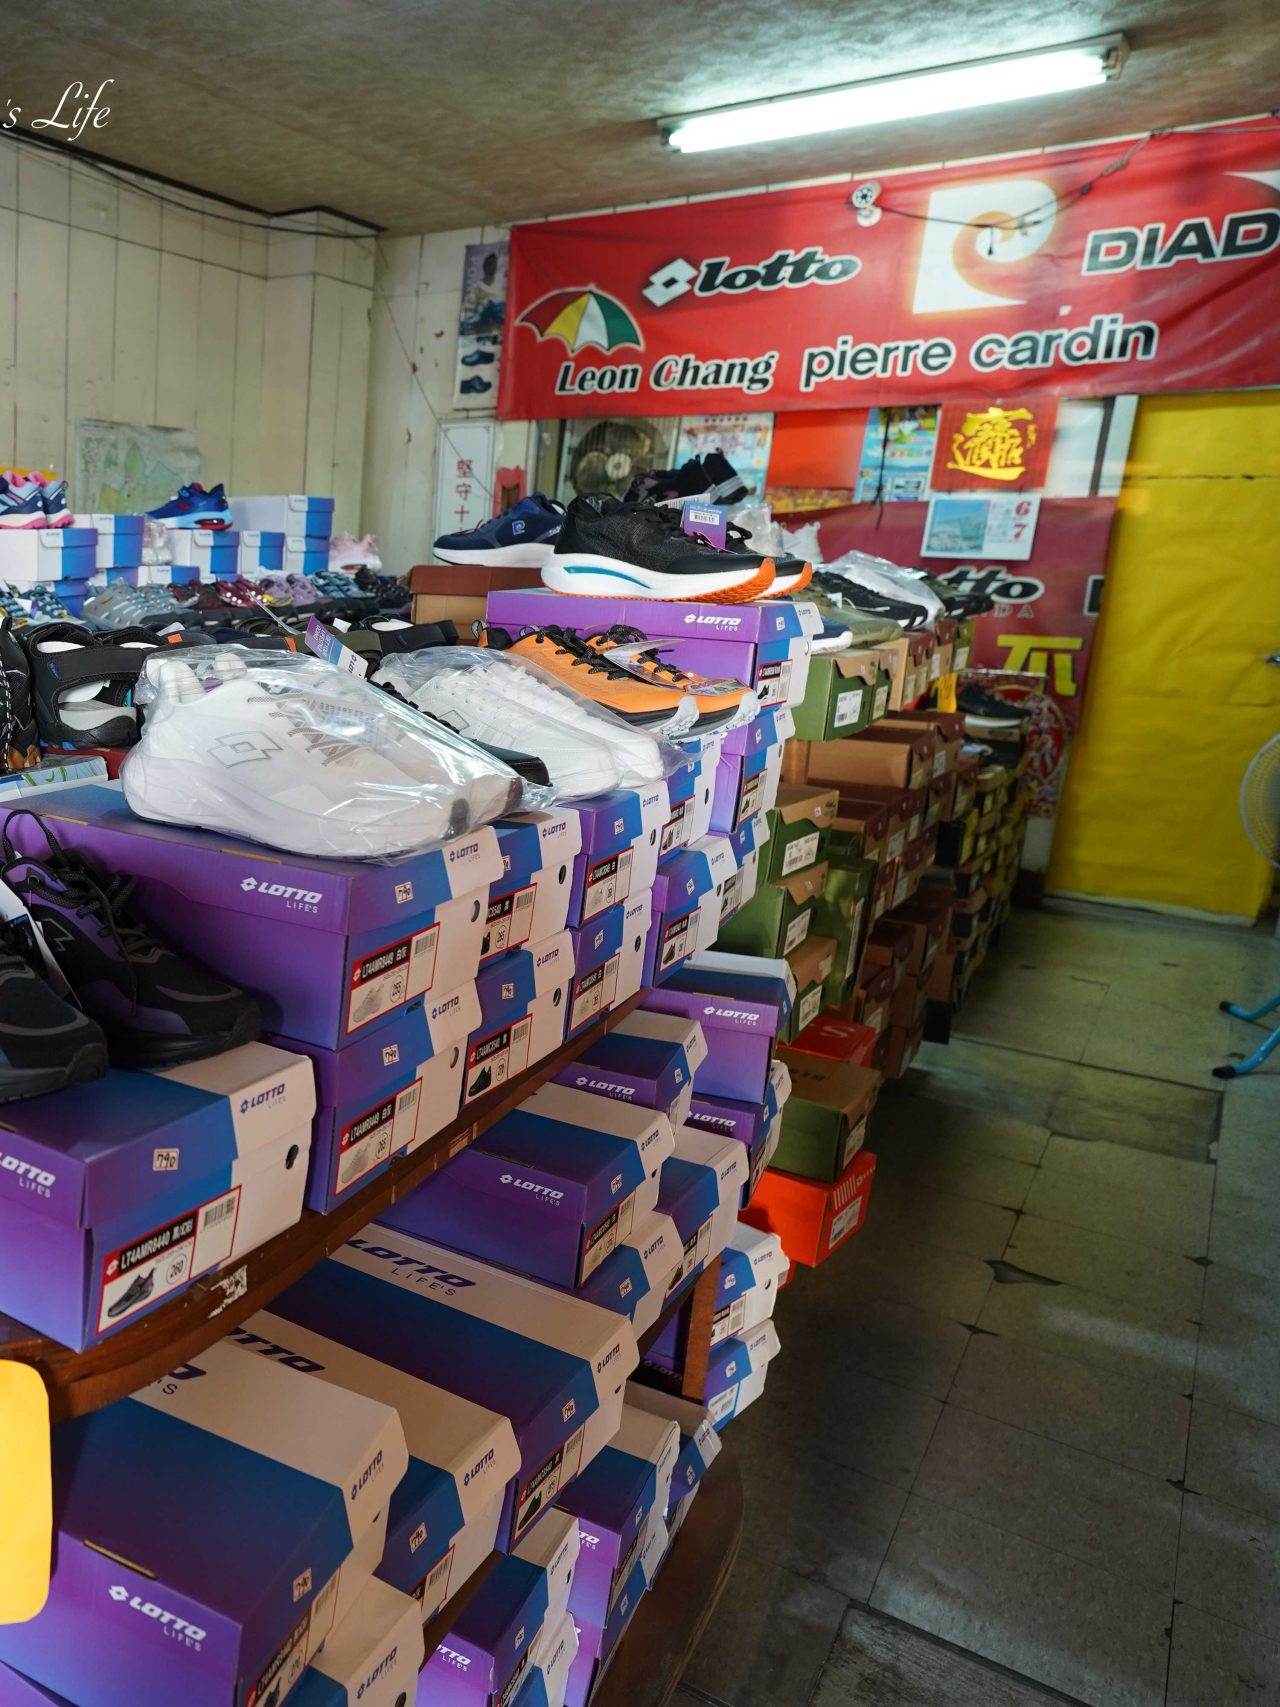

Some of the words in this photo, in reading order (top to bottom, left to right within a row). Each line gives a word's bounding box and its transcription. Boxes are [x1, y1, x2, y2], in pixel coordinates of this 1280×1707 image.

[696, 248, 860, 295] lotto
[800, 336, 956, 391] pierre
[970, 314, 1158, 369] cardin
[556, 362, 641, 395] Leon
[650, 352, 778, 393] Chang
[1015, 501, 1031, 517] 6
[1013, 524, 1028, 540] 7
[697, 615, 741, 625] LOTTO
[548, 822, 566, 836] LOTTO
[456, 844, 479, 859] LOTTO
[258, 882, 323, 904] LOTTO
[542, 949, 560, 964] LOTTO
[438, 996, 459, 1013] LOTTO
[716, 1009, 760, 1021] LOTTO
[251, 1083, 286, 1108] LOTTO
[587, 1081, 635, 1095] LOTTO
[693, 1113, 736, 1127] LOTTO
[644, 1129, 659, 1148] LOTTO
[157, 1153, 176, 1168] 790
[514, 1179, 564, 1199] LOTTO
[648, 1236, 663, 1255] LOTTO
[345, 1239, 477, 1288] LOTTO
[602, 1344, 620, 1368] LOTTO
[358, 1450, 383, 1491] LOTTO
[470, 1448, 494, 1479] LOTTO
[129, 1597, 207, 1640] LOTTO
[365, 1647, 397, 1688] LOTTO
